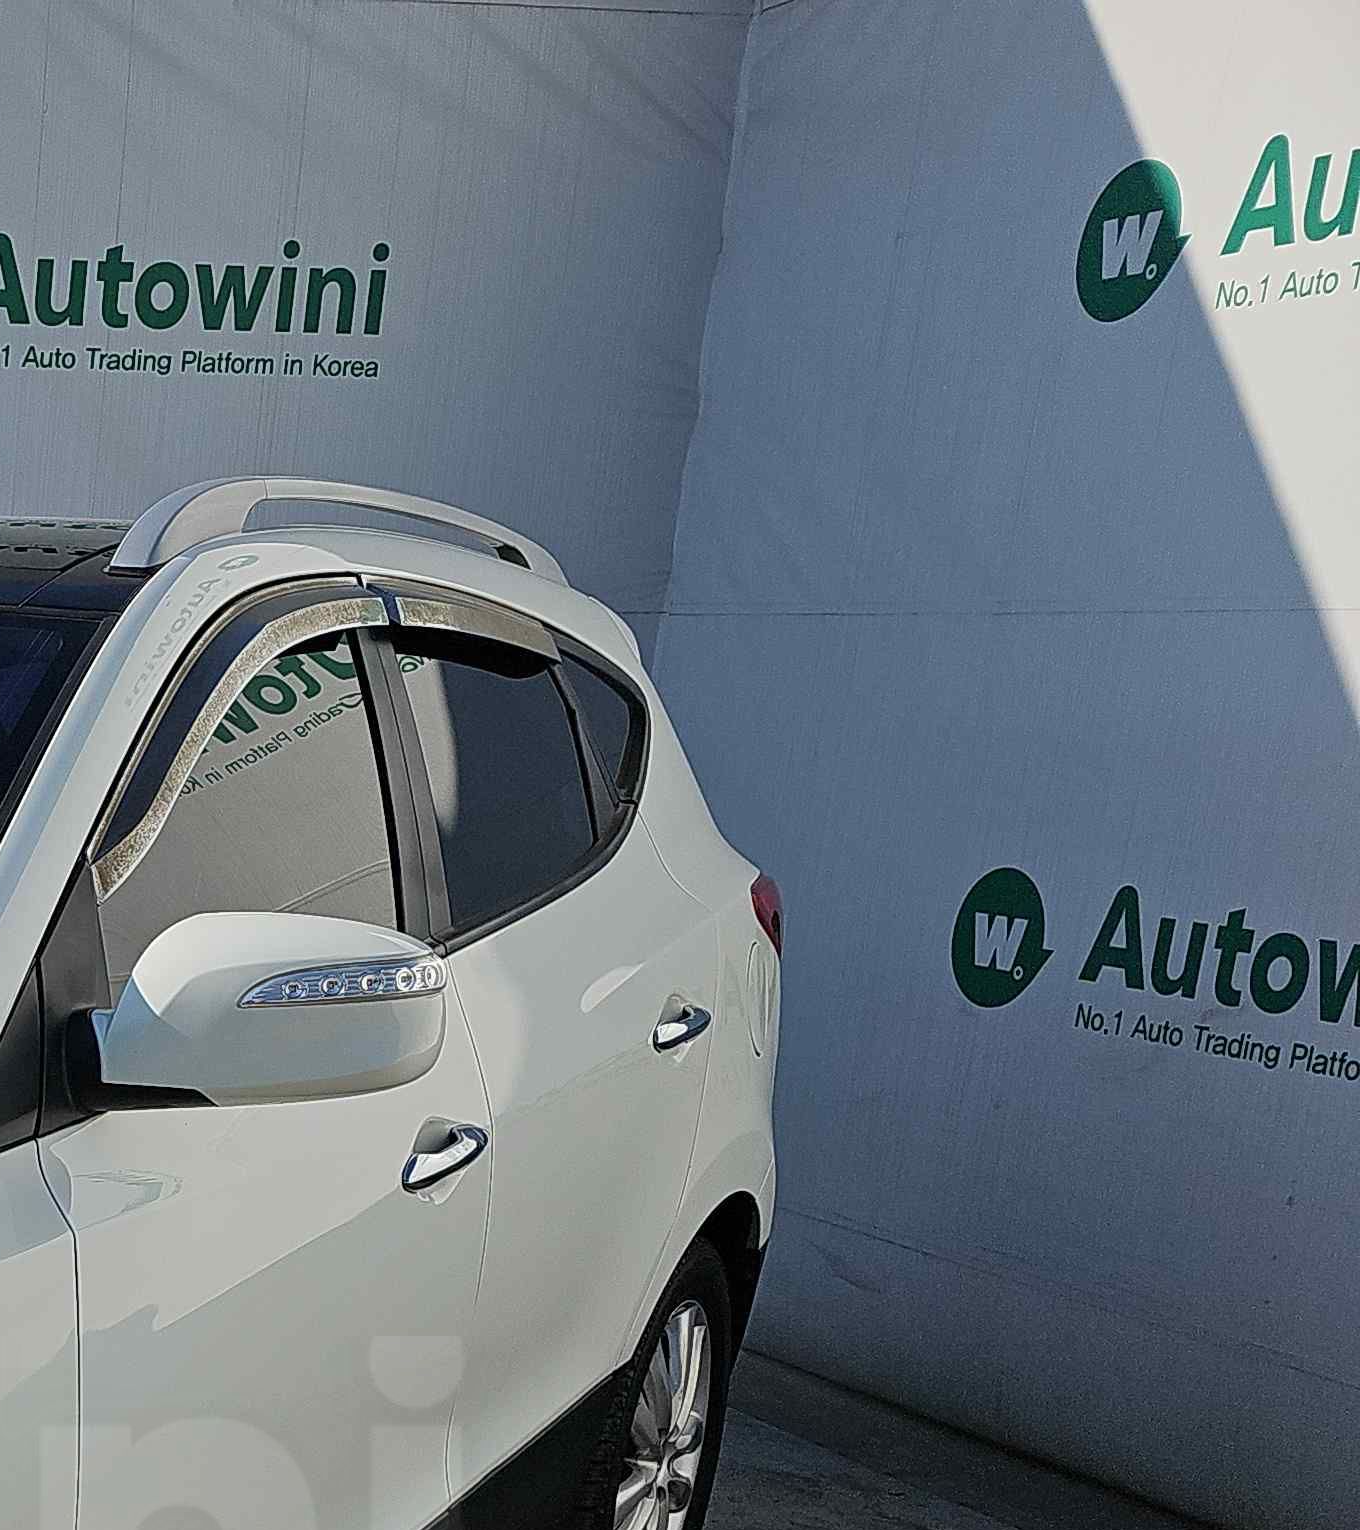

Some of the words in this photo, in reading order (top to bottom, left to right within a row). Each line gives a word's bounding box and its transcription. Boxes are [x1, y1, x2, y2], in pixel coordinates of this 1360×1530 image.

[1215, 273, 1270, 310] No.1
[1278, 268, 1340, 301] Auto
[21, 345, 76, 370] Auto
[85, 347, 172, 376] Trading
[181, 350, 274, 375] Platform
[283, 353, 303, 375] in
[312, 354, 379, 378] Korea
[1074, 1003, 1124, 1036] No.1
[1130, 1014, 1184, 1048] Auto
[1193, 1024, 1282, 1070] Trading
